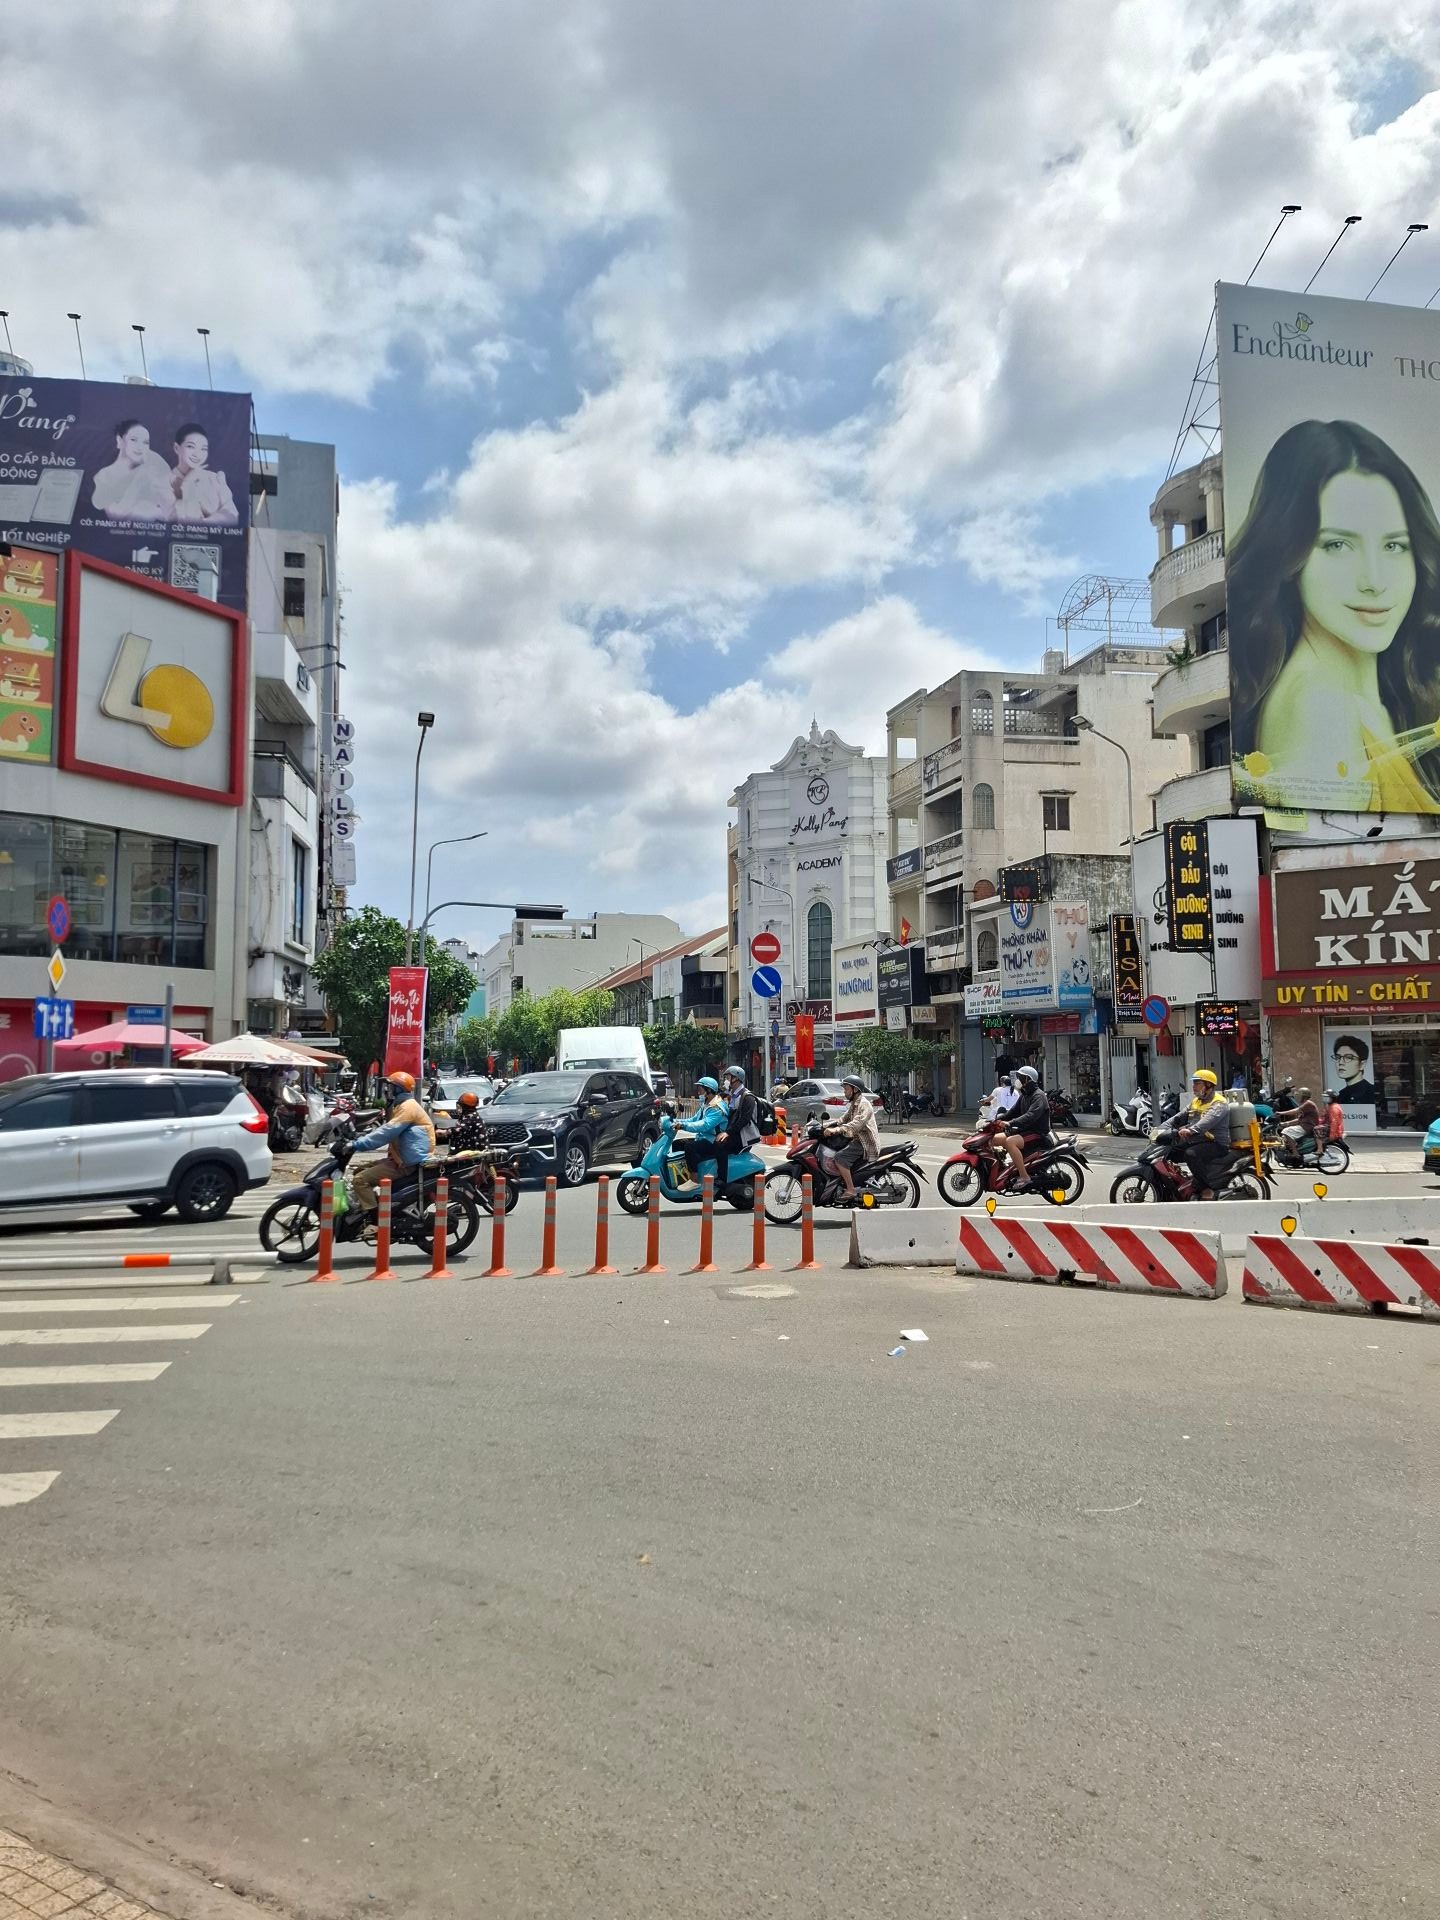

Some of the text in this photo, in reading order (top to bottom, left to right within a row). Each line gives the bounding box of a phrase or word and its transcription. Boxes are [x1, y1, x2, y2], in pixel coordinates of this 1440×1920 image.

[1231, 321, 1374, 368] Enchanteur
[13, 451, 39, 464] CẤP
[41, 452, 77, 466] BẰNG
[0, 466, 38, 480] ĐỘNG
[25, 531, 71, 544] NGHIỆP
[186, 525, 208, 533] PANG
[223, 527, 243, 536] LINH
[336, 723, 350, 836] NAILS
[1180, 831, 1197, 855] GỘI
[797, 856, 842, 871] ACADEMY
[1213, 862, 1228, 877] GỘI
[1320, 861, 1440, 919] MẮ
[1176, 893, 1207, 914] DƯỠNG
[1053, 904, 1088, 925] THÚ
[1216, 909, 1244, 923] DƯỠNG
[1001, 932, 1026, 948] PHÒNG
[1066, 931, 1078, 949] Y
[1181, 924, 1204, 940] SINH
[1217, 937, 1238, 948] SINH
[1314, 919, 1440, 967] KÍN
[1002, 948, 1032, 971] THÚ-Y
[1119, 919, 1140, 991] LISA
[1119, 992, 1140, 1002] Nail
[1276, 986, 1306, 1004] UY
[1312, 980, 1348, 1003] TÍN
[1369, 974, 1432, 1000] CHẤT
[1185, 1026, 1195, 1036] 75
